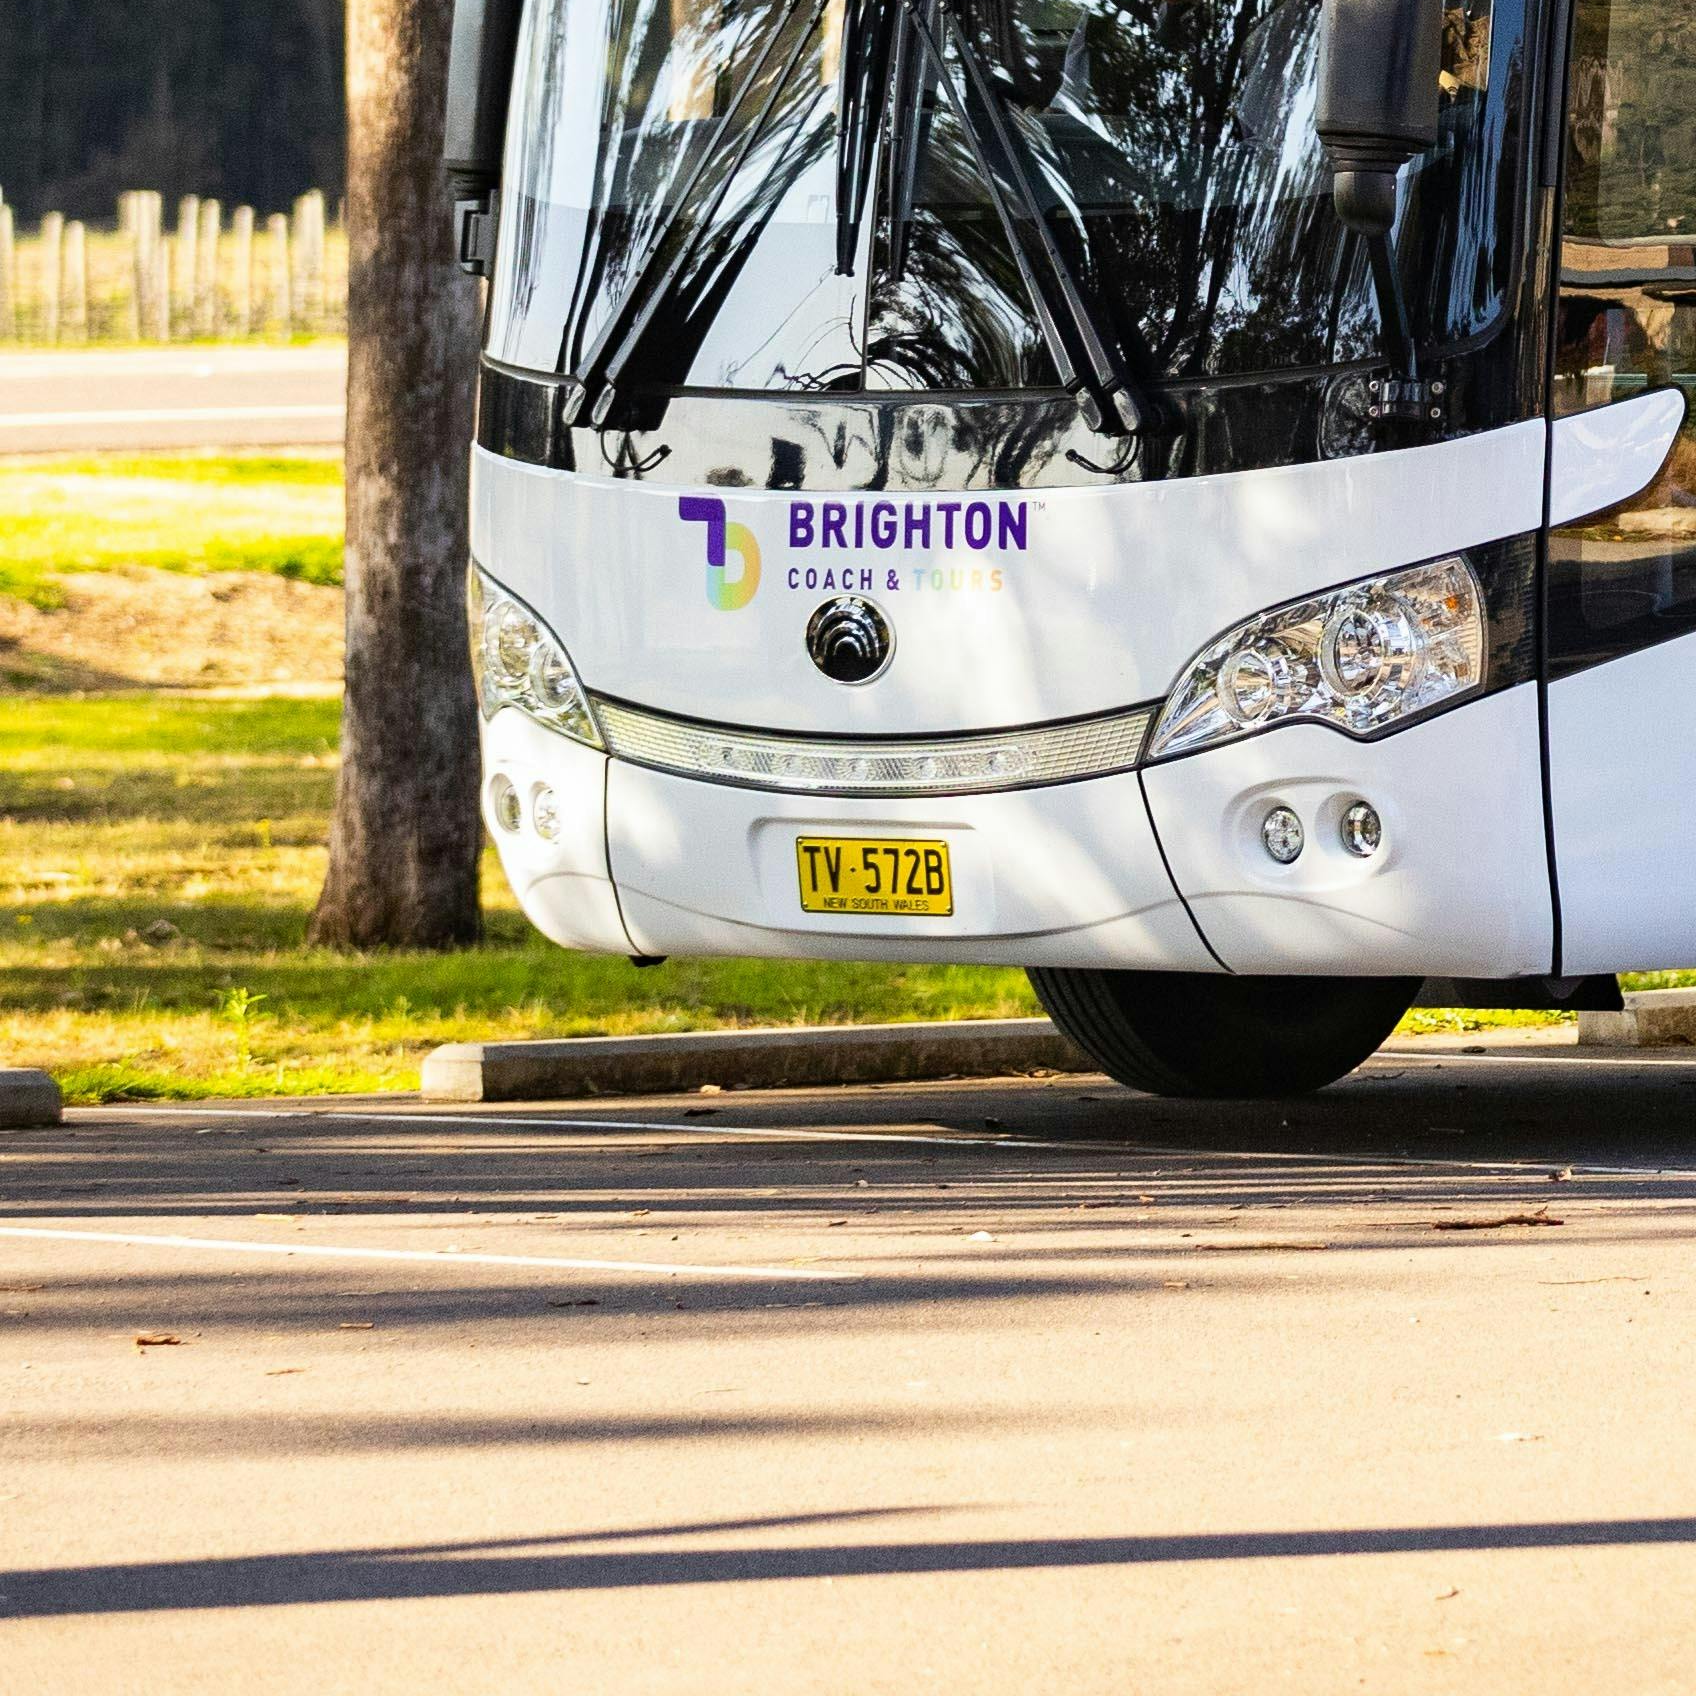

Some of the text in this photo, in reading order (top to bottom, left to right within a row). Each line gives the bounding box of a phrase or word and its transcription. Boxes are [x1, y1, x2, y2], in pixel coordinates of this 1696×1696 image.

[789, 500, 1028, 551] BRIGHTON
[788, 567, 1004, 592] COACH & TOURS
[823, 896, 930, 912] NEW SOUTH WALES
